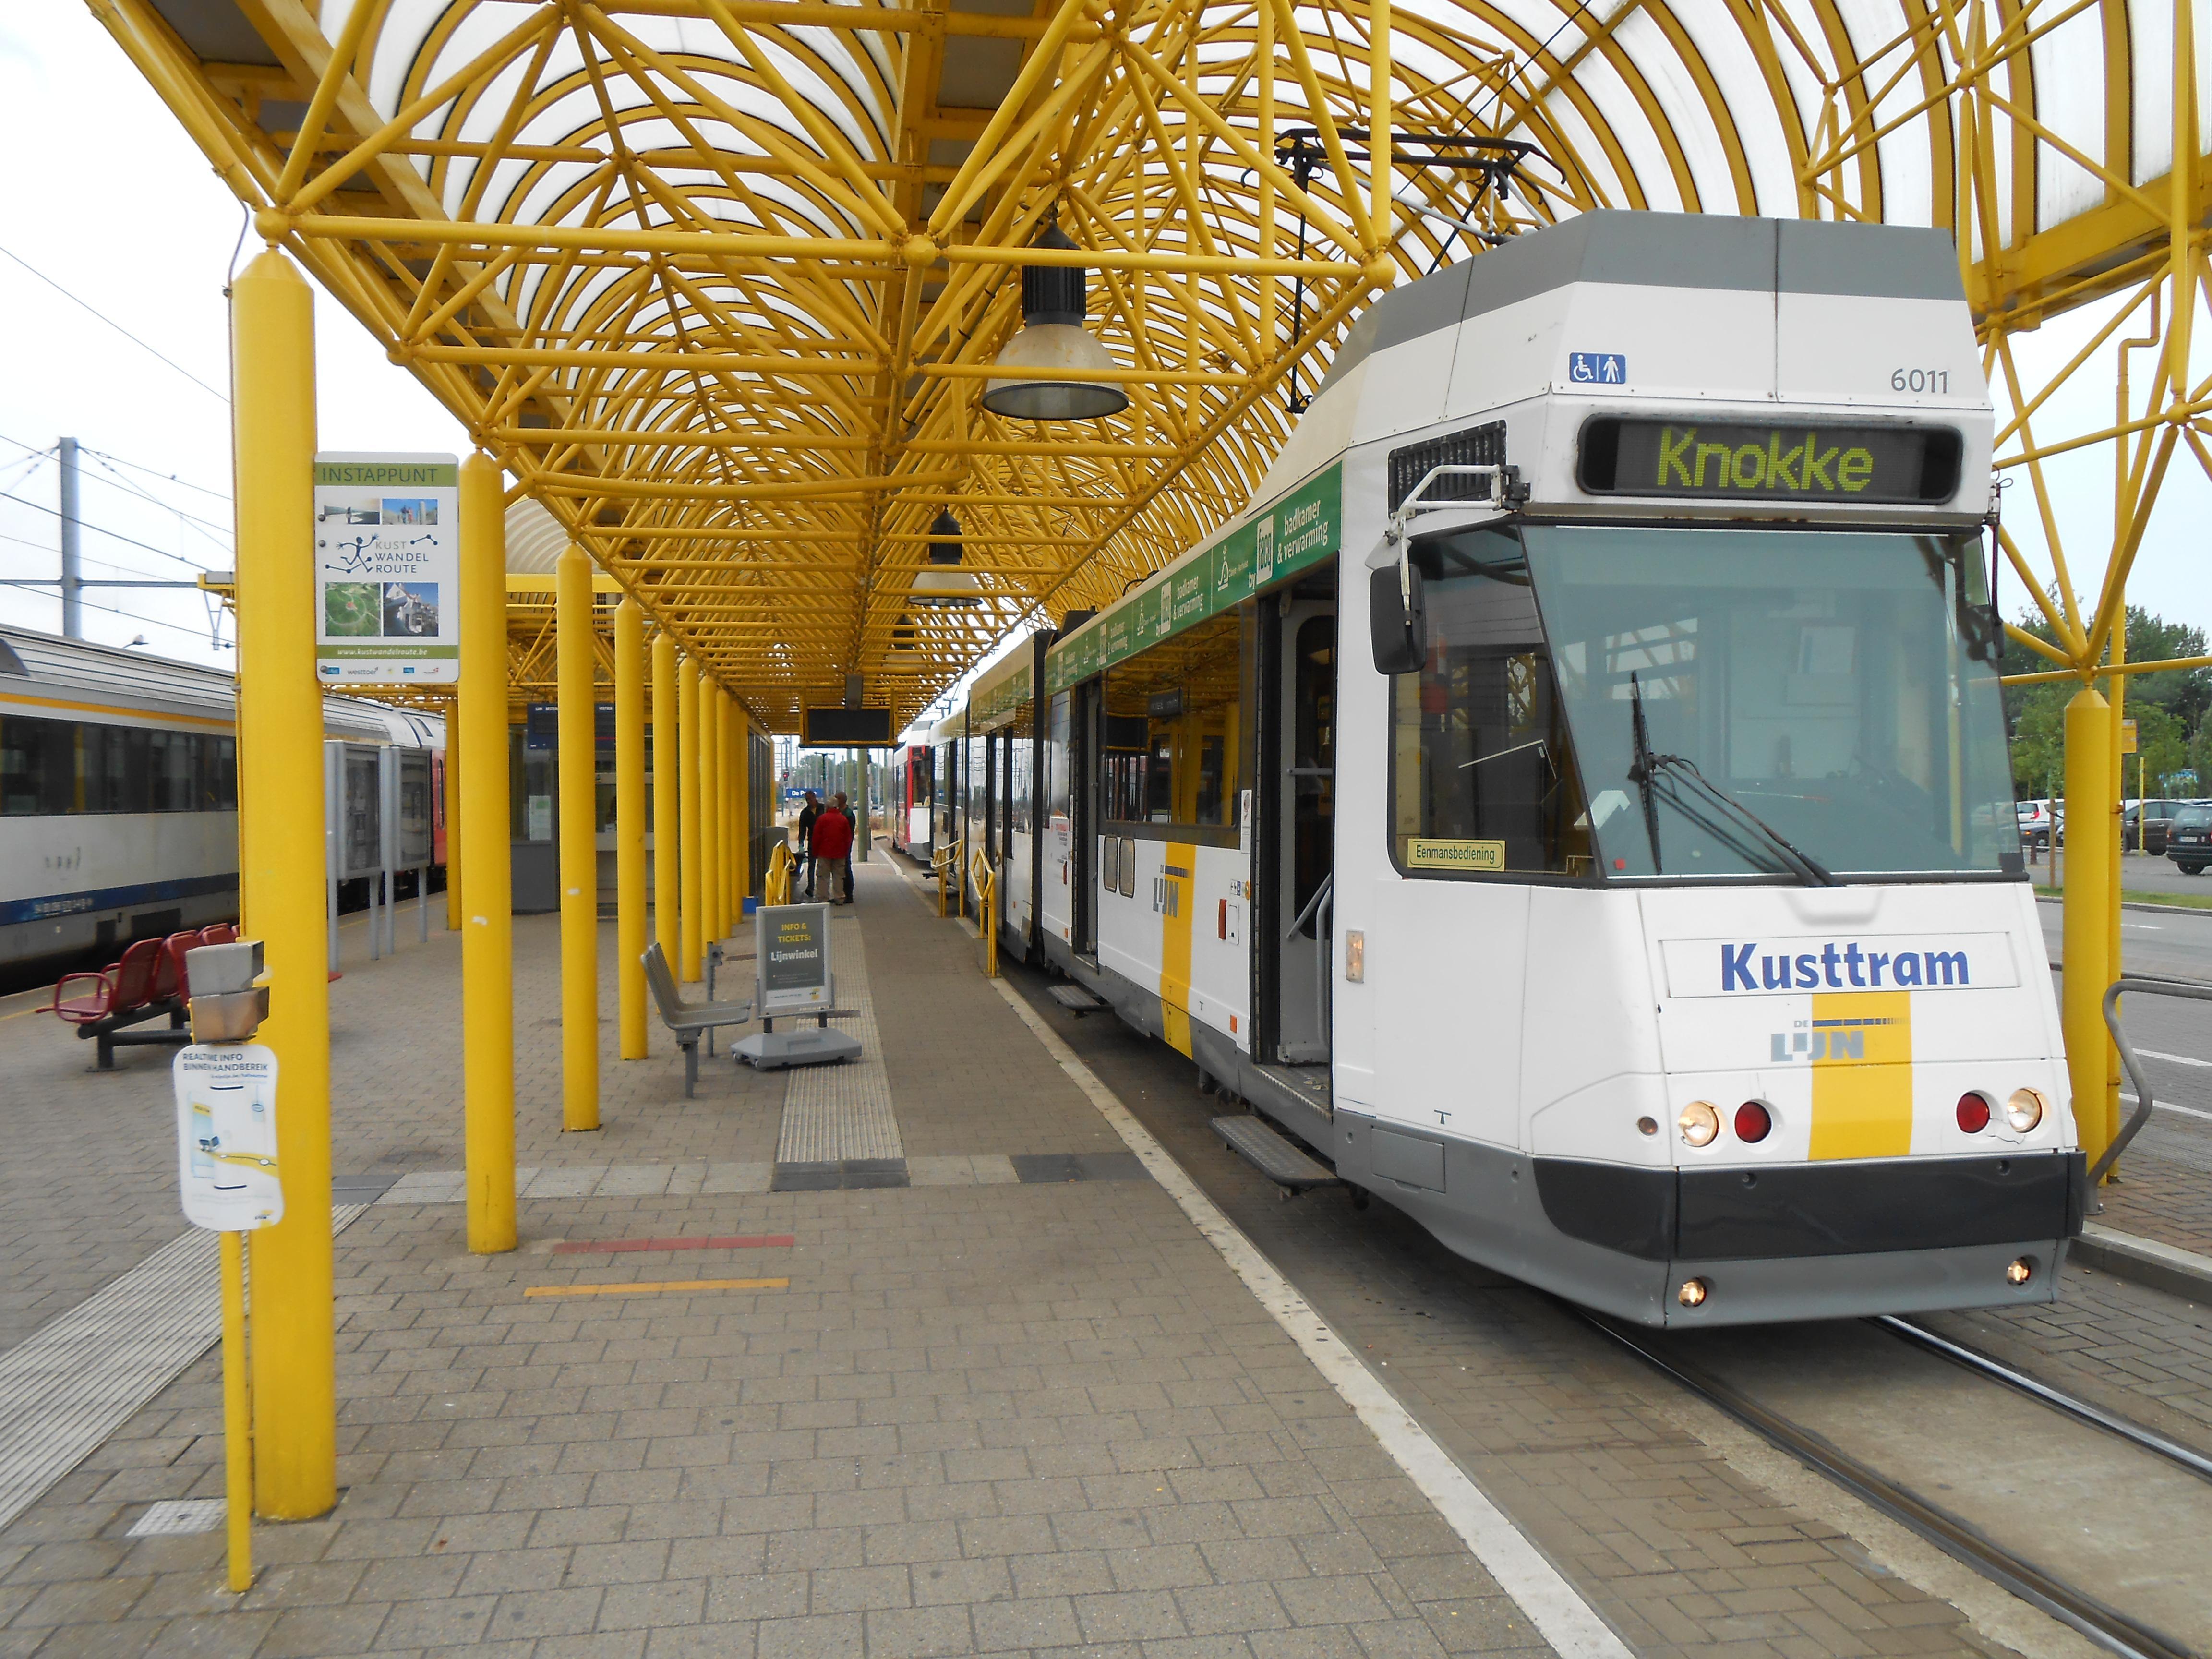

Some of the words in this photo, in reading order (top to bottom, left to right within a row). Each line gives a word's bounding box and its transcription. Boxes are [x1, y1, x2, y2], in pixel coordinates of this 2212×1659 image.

[1891, 368, 1949, 394] 6011
[1657, 427, 1874, 492] Knokke
[322, 468, 438, 482] INSTAPPUNT
[1284, 499, 1321, 536] badkamer
[1277, 543, 1283, 565] &
[1284, 521, 1328, 560] verwarming
[375, 553, 429, 561] WANDEL
[376, 565, 417, 573] ROUTE
[1249, 571, 1256, 589] by
[1416, 845, 1495, 864] Eenmansbediening
[778, 934, 811, 943] TICKETS:
[771, 949, 818, 962] Lijnwinkel
[1721, 942, 1970, 992] Kusttram
[1794, 1020, 1809, 1028] DE
[1770, 1030, 1864, 1062] LIJN
[220, 1053, 243, 1061] INFO
